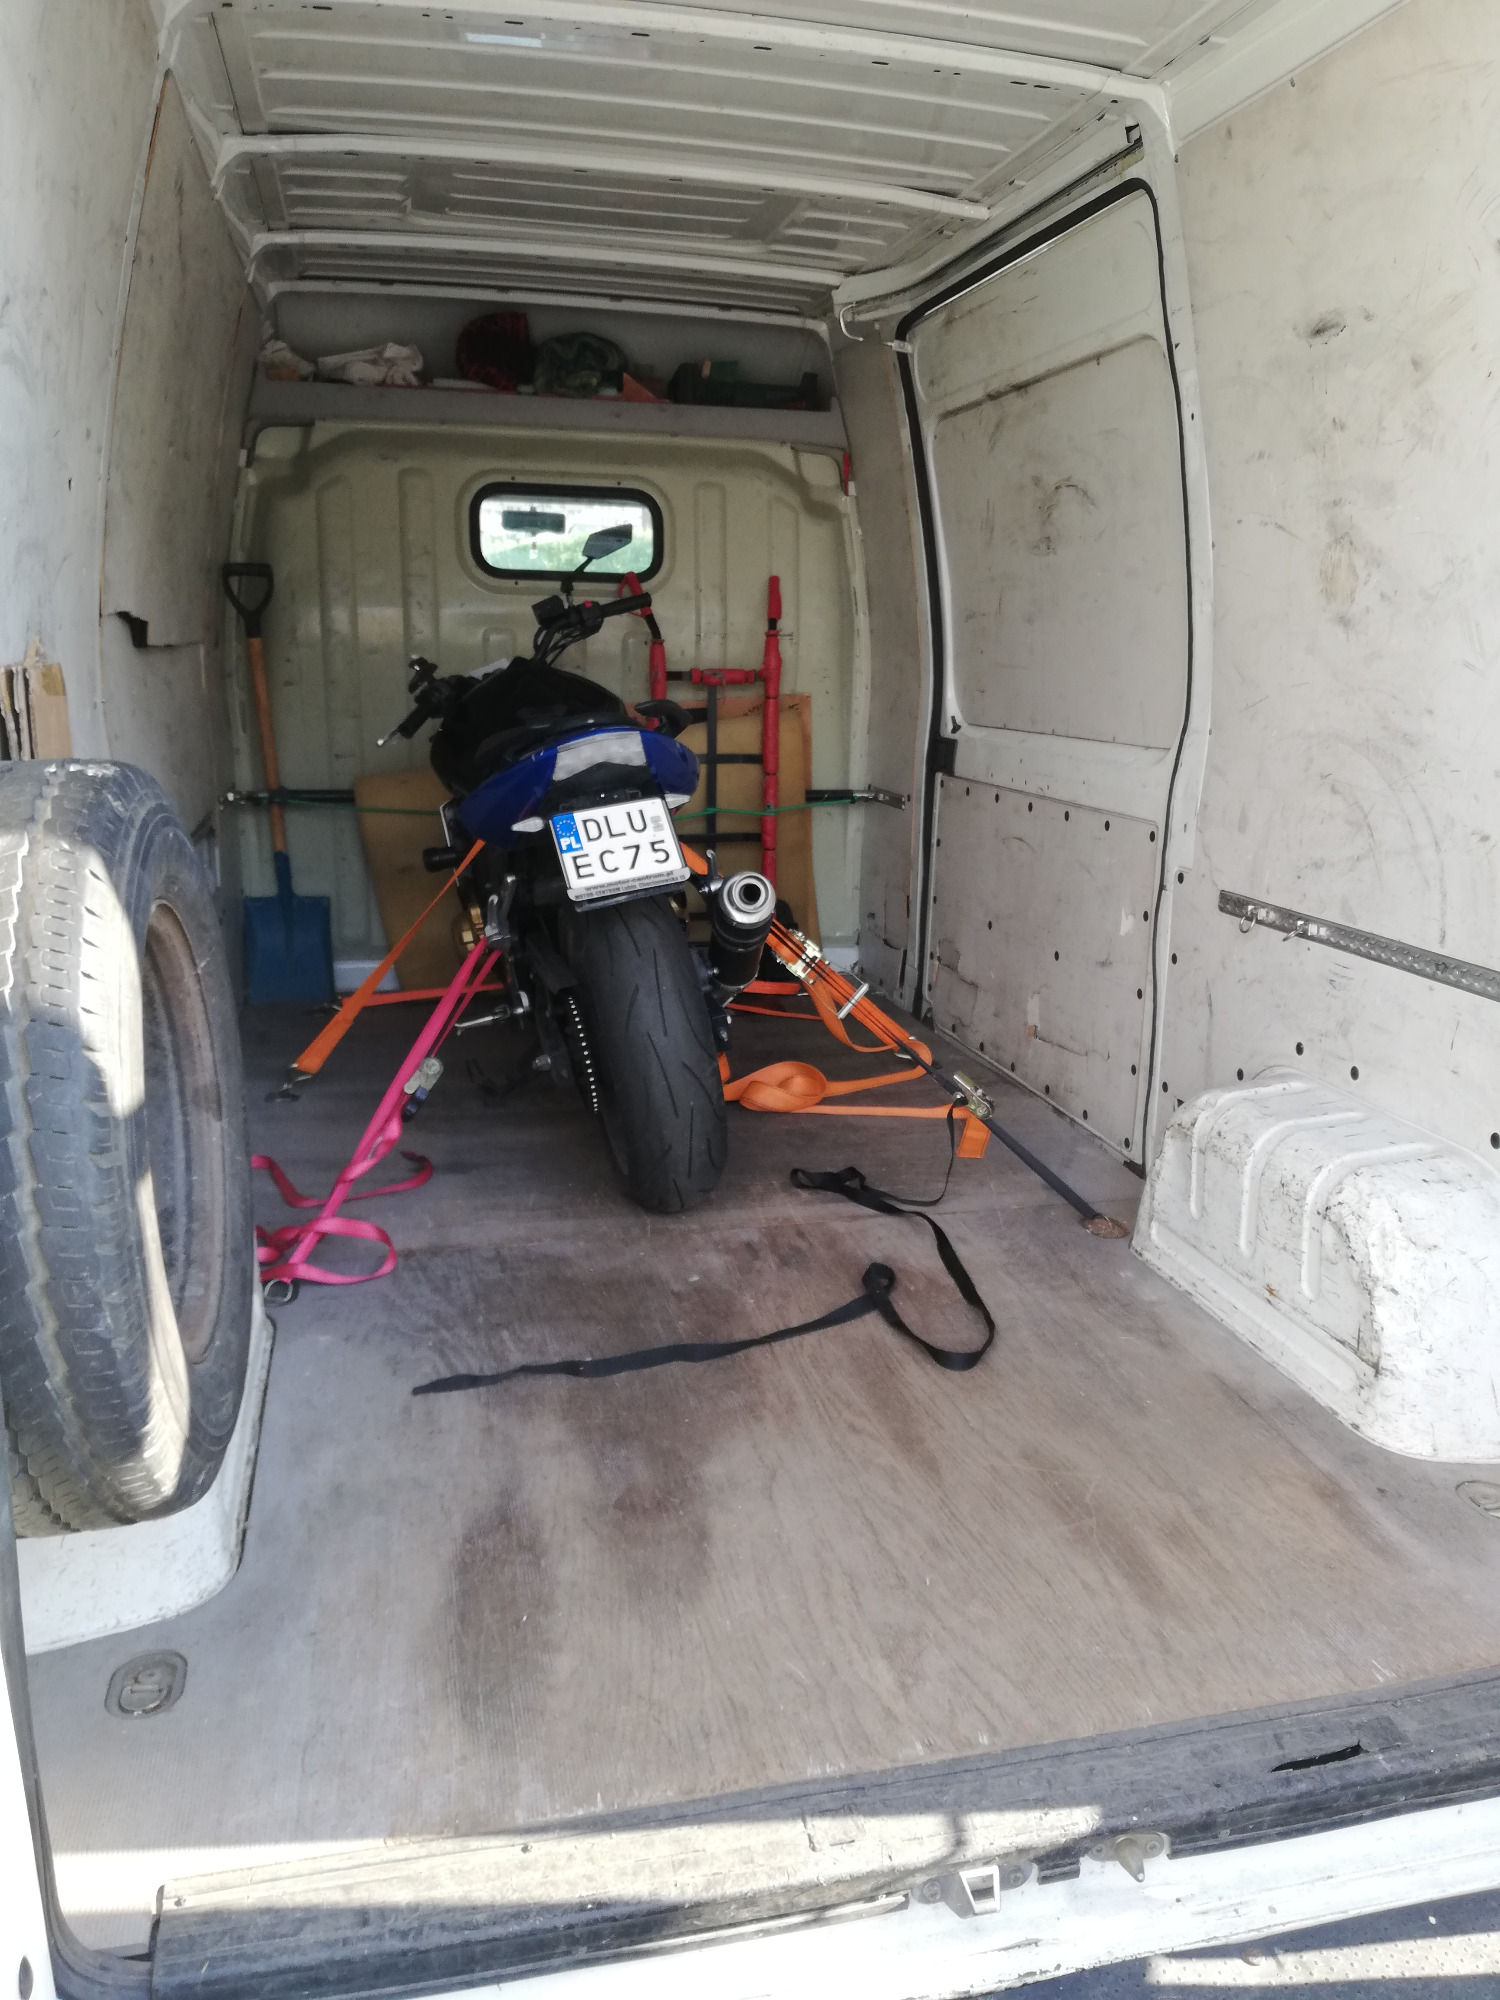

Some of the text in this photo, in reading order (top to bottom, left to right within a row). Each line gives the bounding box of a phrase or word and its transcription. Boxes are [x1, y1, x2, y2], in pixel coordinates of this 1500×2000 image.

[581, 809, 648, 842] DLU
[559, 836, 582, 851] PL
[571, 839, 670, 880] EC75
